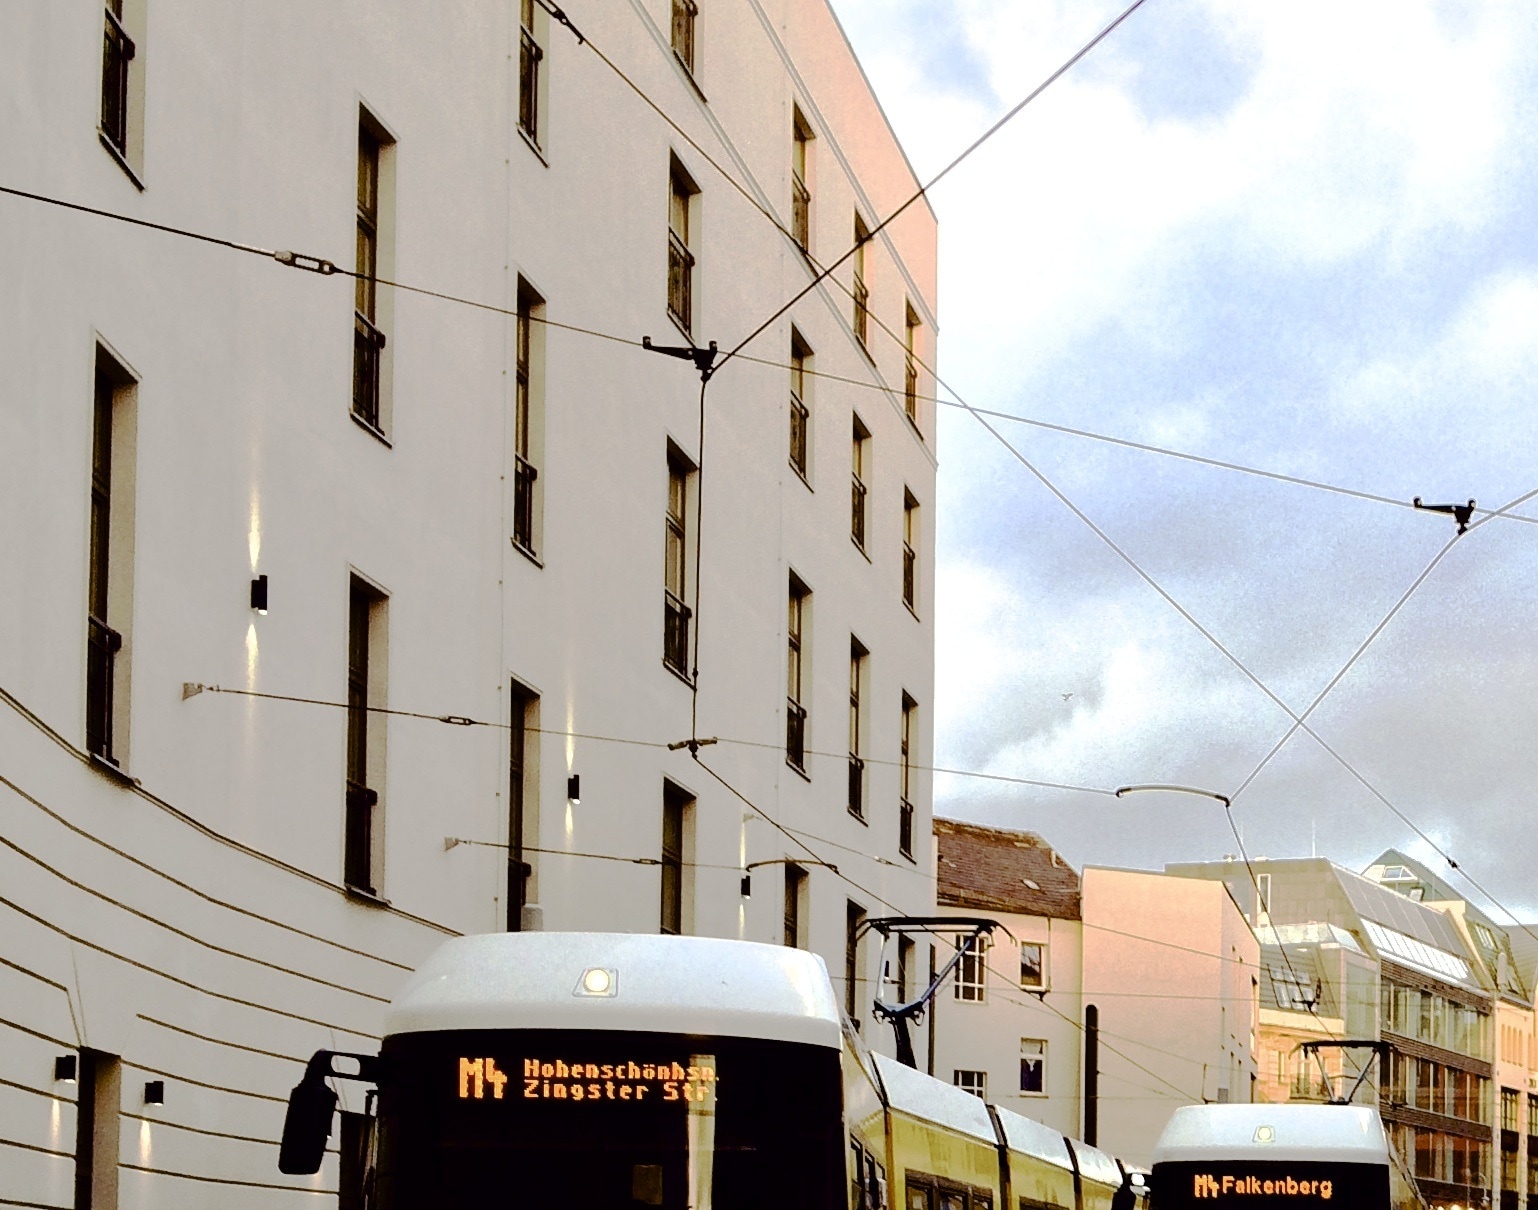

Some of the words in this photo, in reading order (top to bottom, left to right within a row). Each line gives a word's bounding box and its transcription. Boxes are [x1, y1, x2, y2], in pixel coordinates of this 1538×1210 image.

[459, 1056, 508, 1099] M4
[523, 1058, 720, 1081] Hohenschönhsn.
[523, 1079, 649, 1101] Zingster
[662, 1081, 718, 1101] Str.
[1194, 1174, 1220, 1198] M4
[1222, 1175, 1333, 1199] Falkenberg
